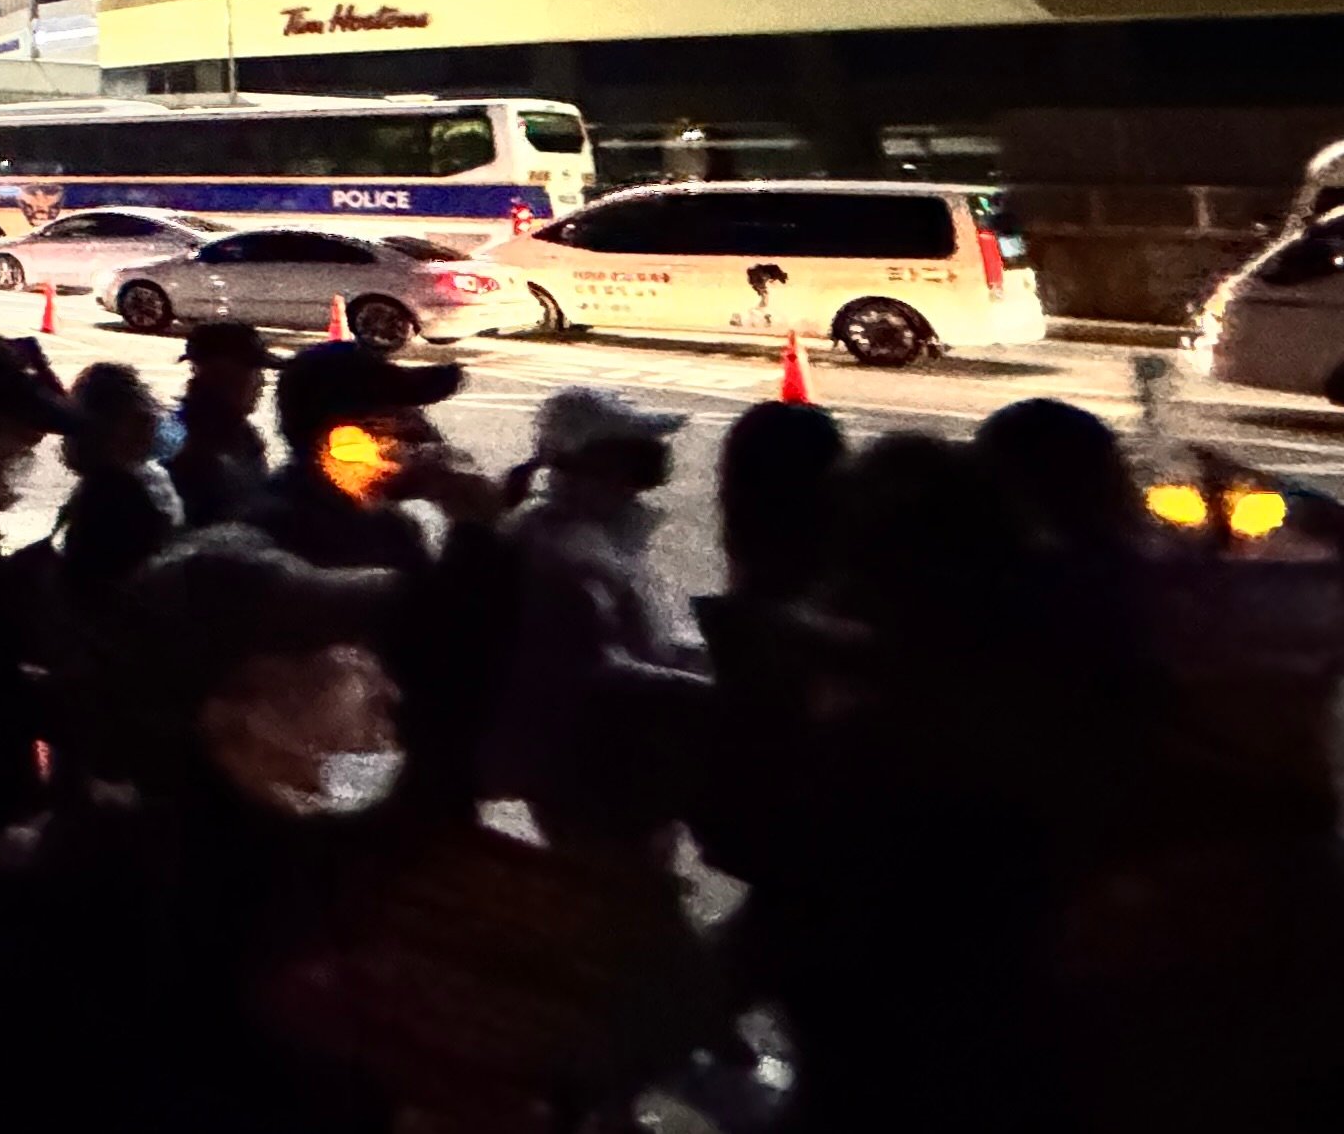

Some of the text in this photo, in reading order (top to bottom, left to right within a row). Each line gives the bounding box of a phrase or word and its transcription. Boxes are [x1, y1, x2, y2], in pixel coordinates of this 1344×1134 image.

[280, 4, 431, 36] Tim Hortons
[333, 190, 411, 209] POLICE
